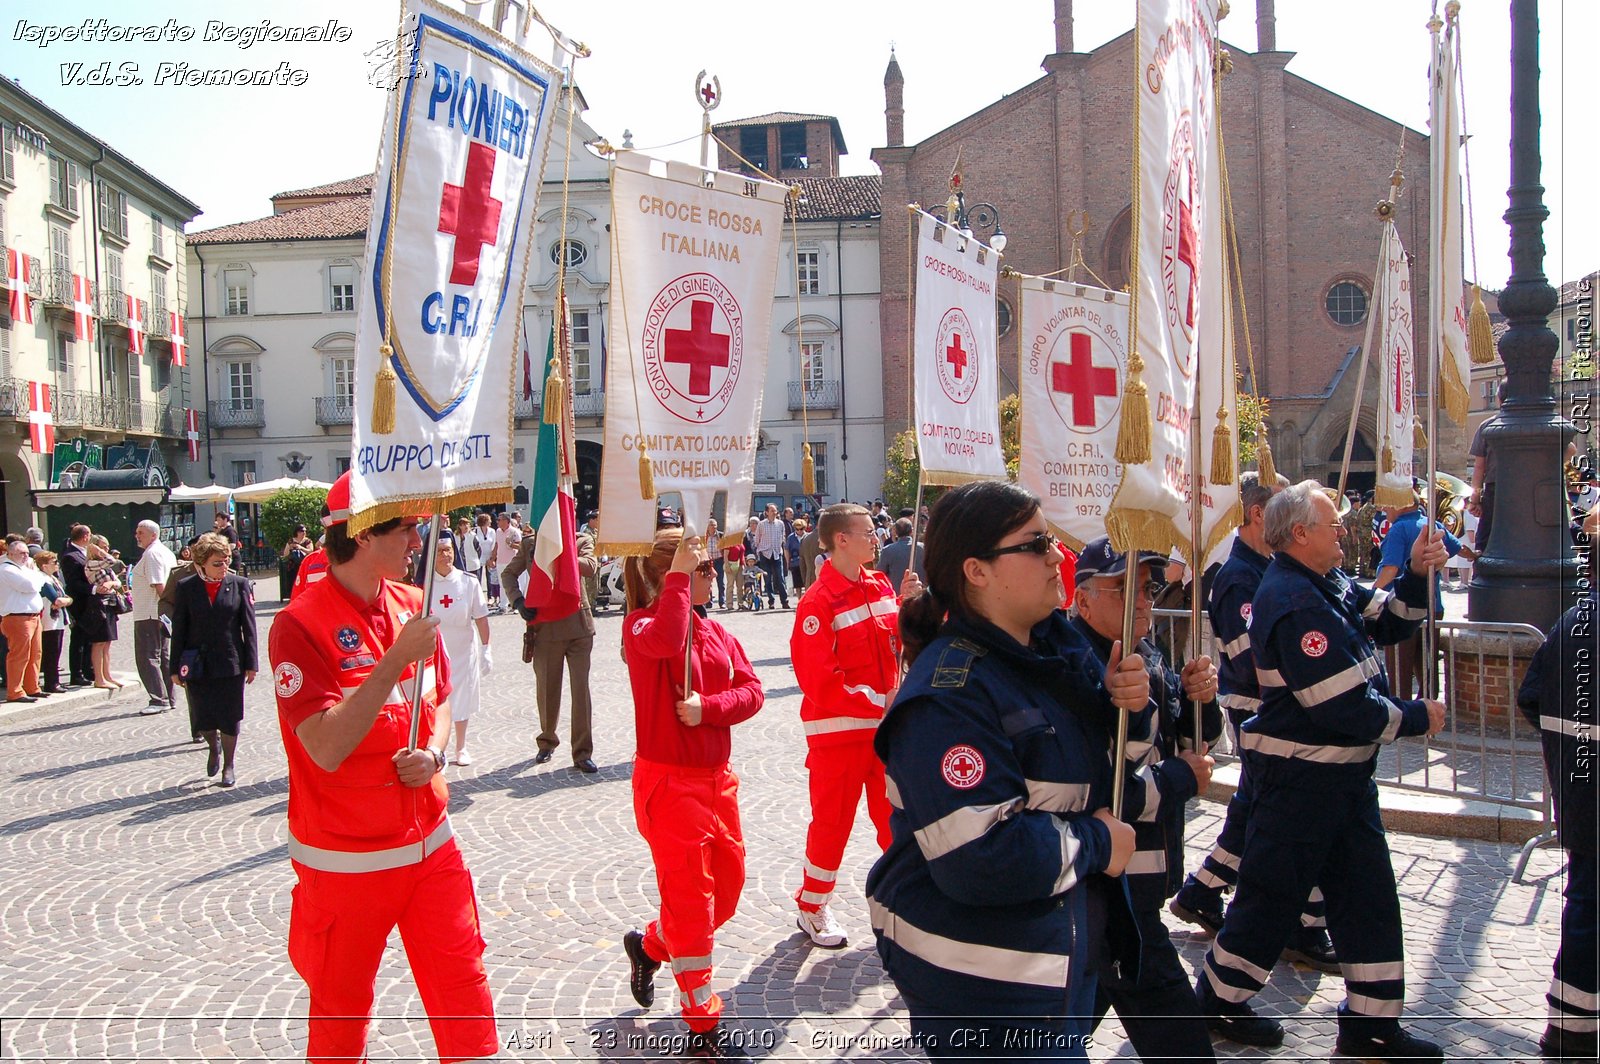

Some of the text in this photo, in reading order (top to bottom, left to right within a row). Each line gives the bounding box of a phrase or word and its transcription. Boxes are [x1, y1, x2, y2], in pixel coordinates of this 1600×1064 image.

[427, 62, 530, 160] PIONIERI
[638, 194, 763, 236] CROCE ROSSA
[661, 231, 741, 264] ITALIANA
[645, 296, 670, 400] CONVENZIONE
[667, 287, 681, 300] DI
[681, 278, 724, 302] GINEVRA
[723, 297, 737, 316] 22
[730, 316, 742, 376] AGOSTO
[1029, 334, 1047, 375] CORPO
[1087, 310, 1102, 328] DEL
[358, 434, 492, 476] GRUPPO DI ASTI
[621, 433, 751, 452] COMITATO LOCALE
[1067, 442, 1104, 459] C.R.I.
[653, 458, 730, 478] NICHELINO
[1043, 461, 1109, 477] COMITATO
[1075, 505, 1102, 516] 1972
